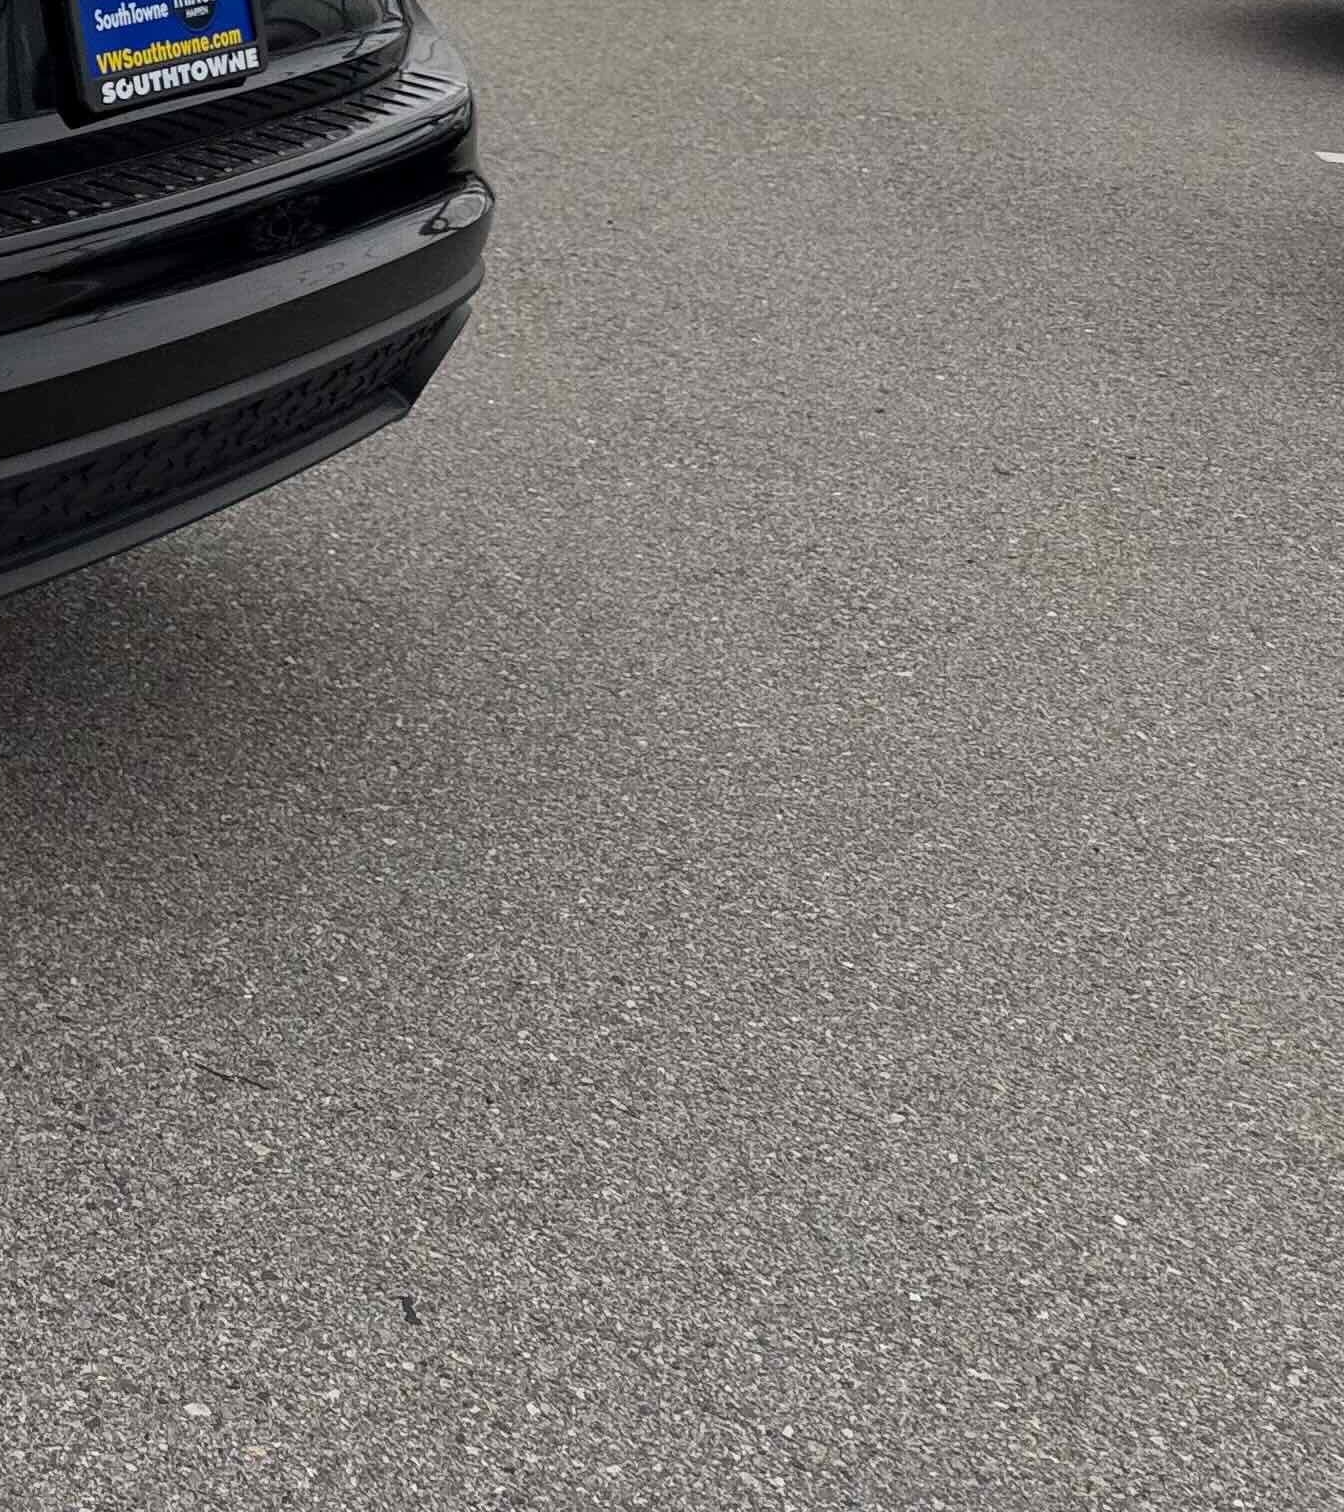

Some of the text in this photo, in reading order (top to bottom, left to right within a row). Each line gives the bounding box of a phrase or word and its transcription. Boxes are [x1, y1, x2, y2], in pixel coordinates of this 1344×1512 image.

[94, 2, 169, 31] SouthTowne
[96, 29, 242, 74] VWSouthtowne.com
[101, 48, 260, 104] SOUTHTOWNE
